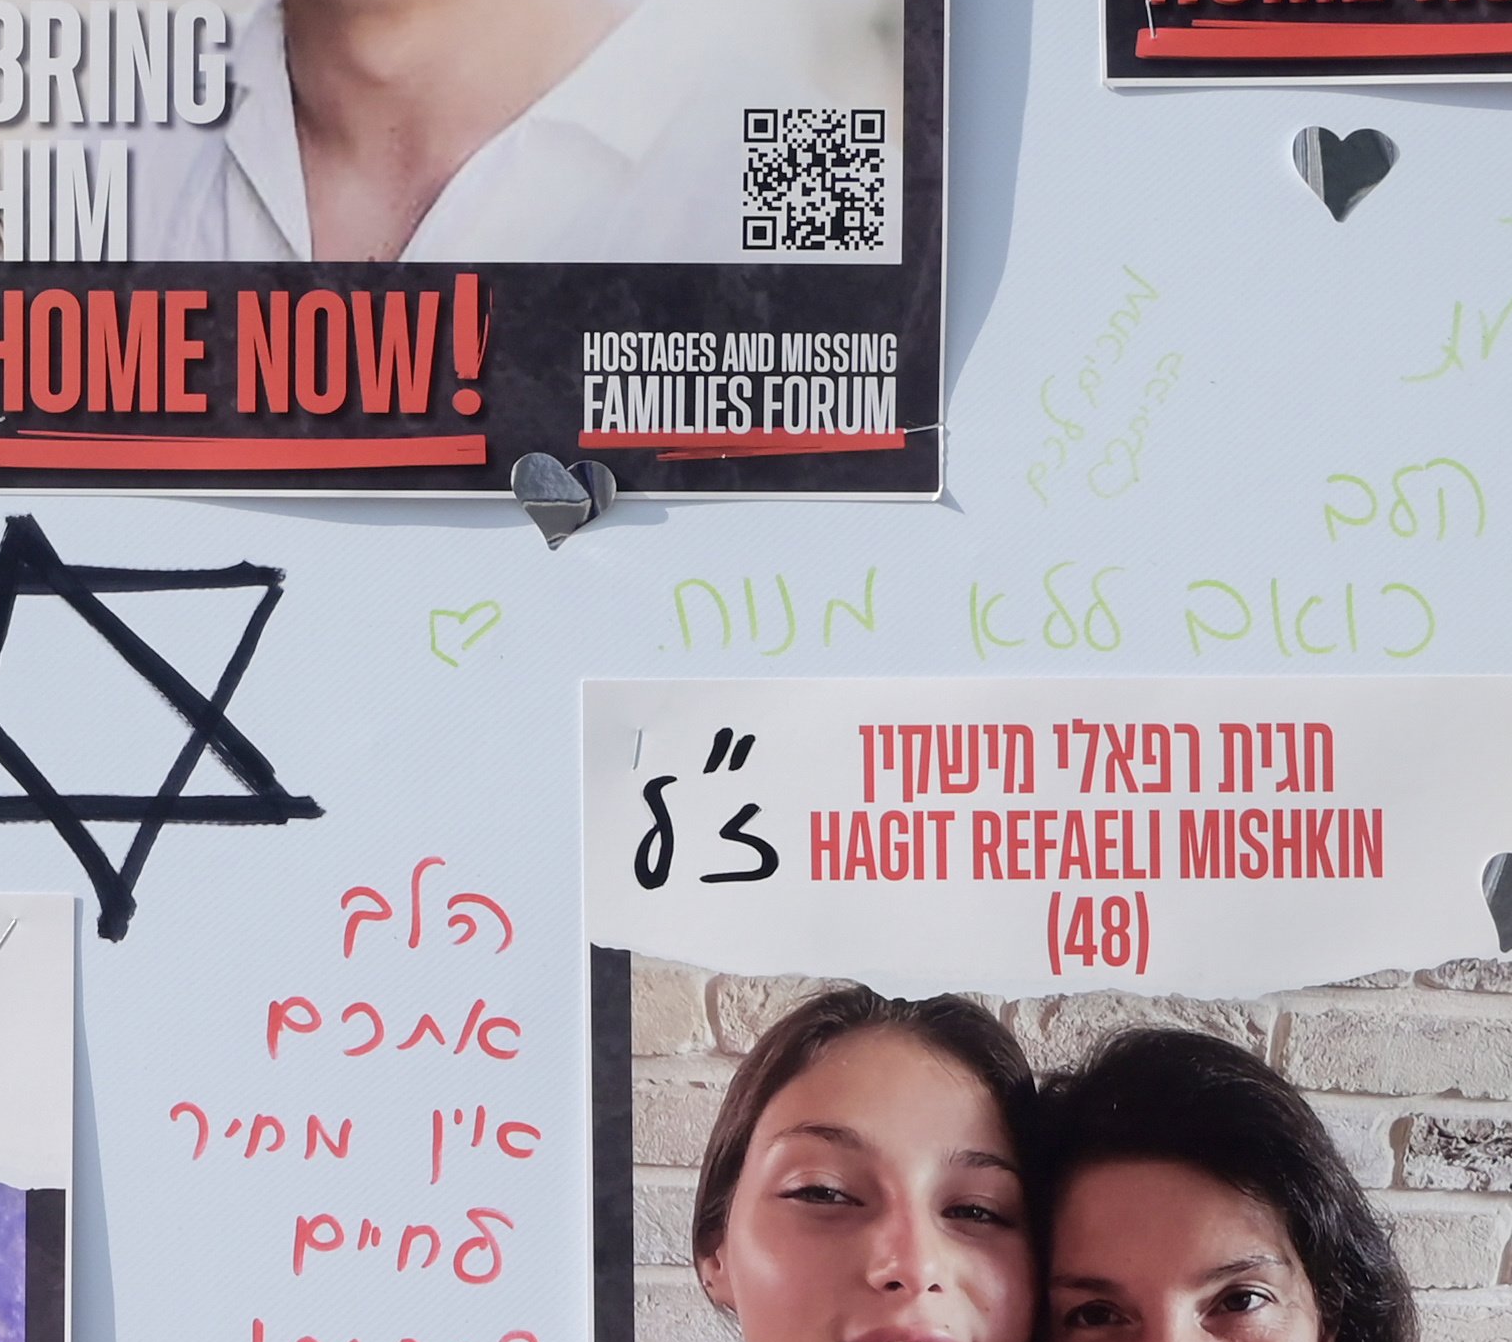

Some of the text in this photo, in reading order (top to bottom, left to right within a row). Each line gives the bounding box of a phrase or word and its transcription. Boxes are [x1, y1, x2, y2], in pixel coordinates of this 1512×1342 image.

[584, 332, 897, 373] HOSTAGES AND MISSING
[584, 376, 896, 435] FAMILIES FORUM
[1321, 457, 1487, 543] הלב
[969, 560, 1125, 661] ללא
[1184, 576, 1436, 659] כואב
[859, 718, 1334, 803] חגית רפאלי מישקין
[812, 808, 1384, 881] HAGIT REFAELI MISHKIN
[339, 856, 513, 958] הלב
[1048, 891, 1150, 976] (48)
[266, 995, 522, 1061] אתכם
[169, 1100, 543, 1186] אין מחיר
[291, 1207, 513, 1285] לחיים
